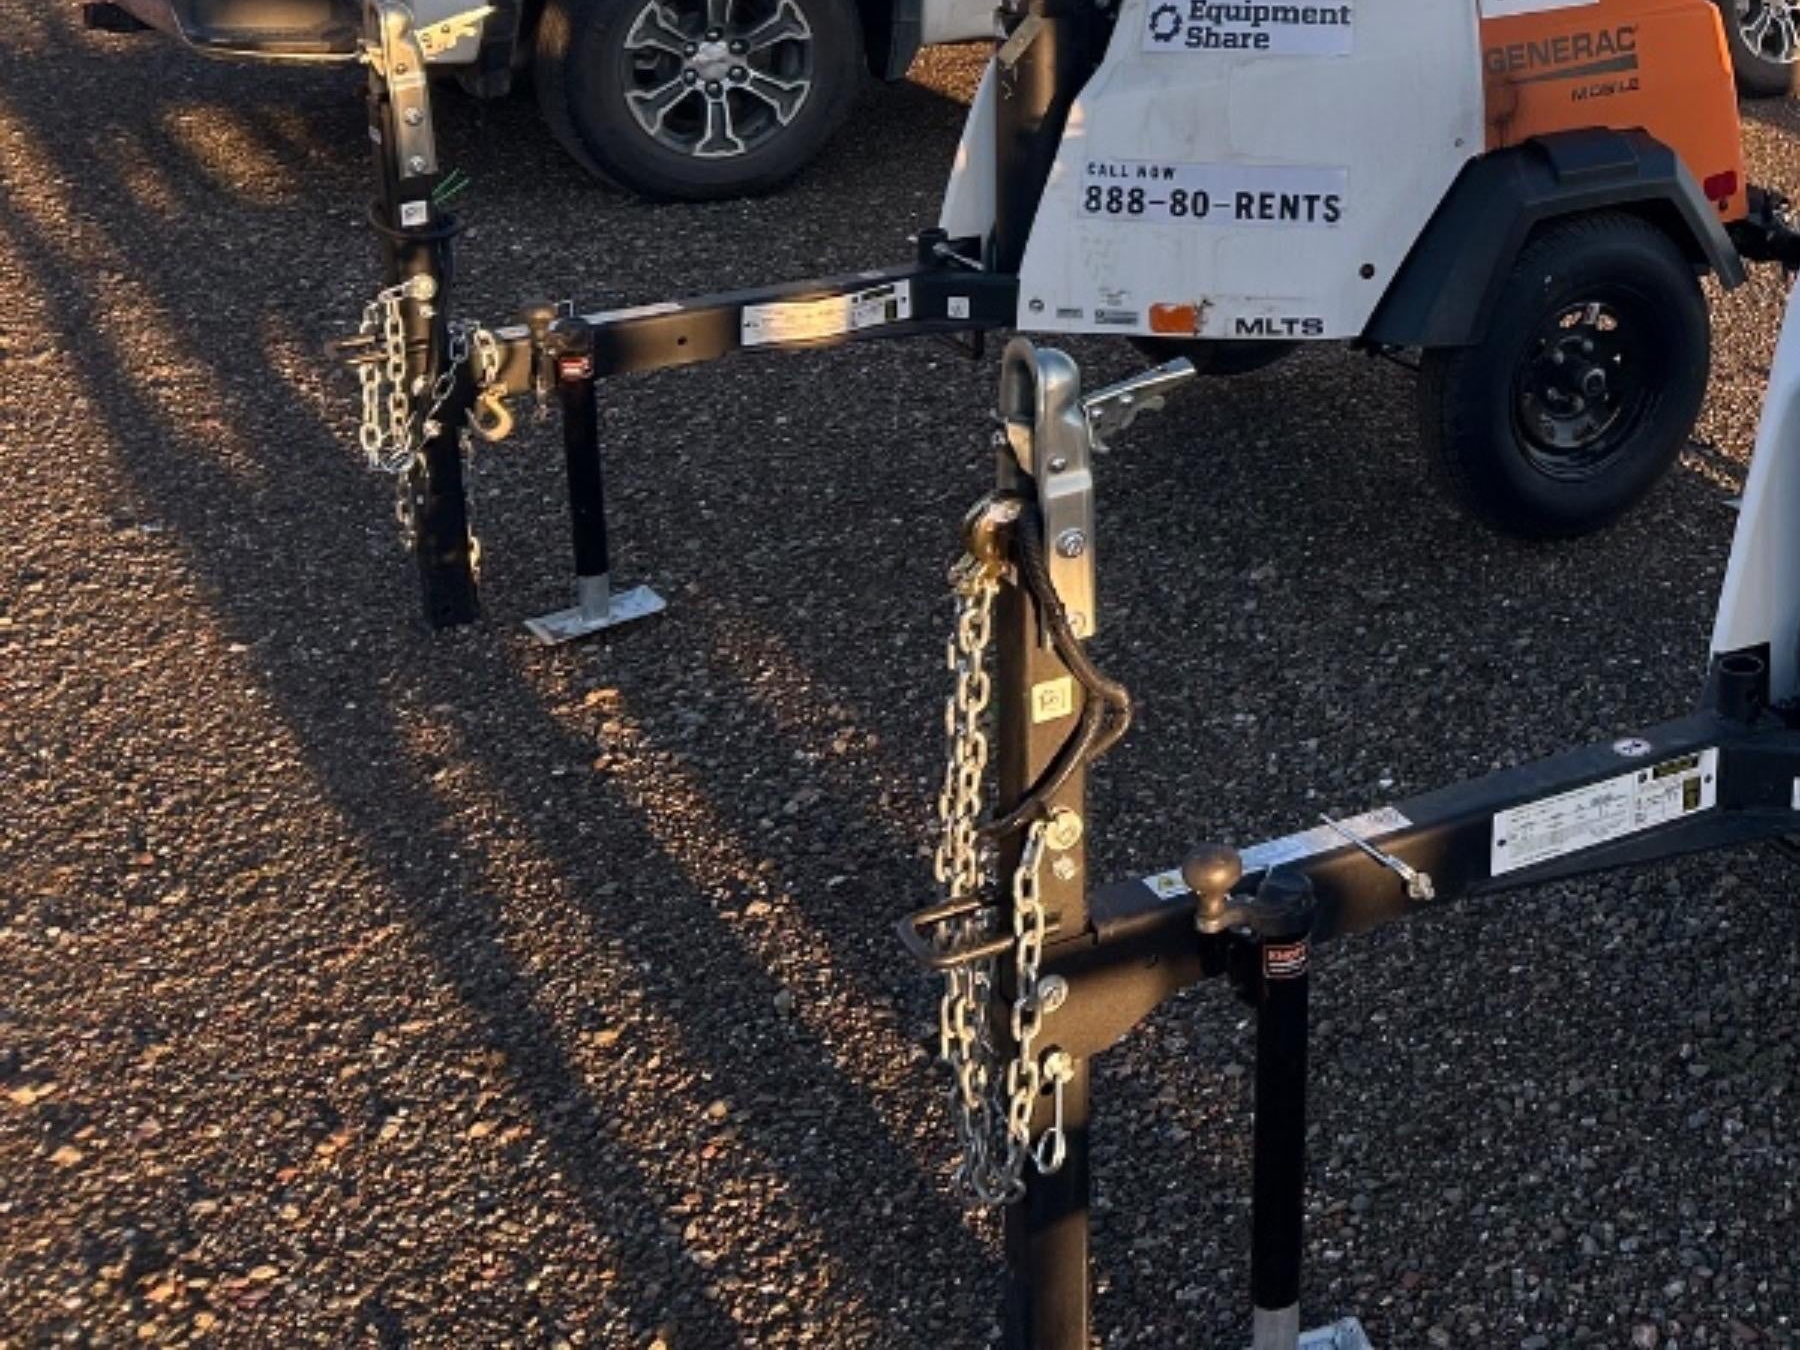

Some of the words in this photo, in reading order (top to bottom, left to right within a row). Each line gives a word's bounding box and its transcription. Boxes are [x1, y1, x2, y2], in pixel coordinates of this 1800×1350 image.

[1188, 0, 1351, 27] Equipment
[1184, 26, 1270, 50] Share
[1486, 25, 1637, 74] GENERAC
[1087, 162, 1129, 178] CALL
[1136, 166, 1177, 180] NOW
[1083, 184, 1342, 224] 888-80-RENTS
[1234, 318, 1324, 335] MLTS
